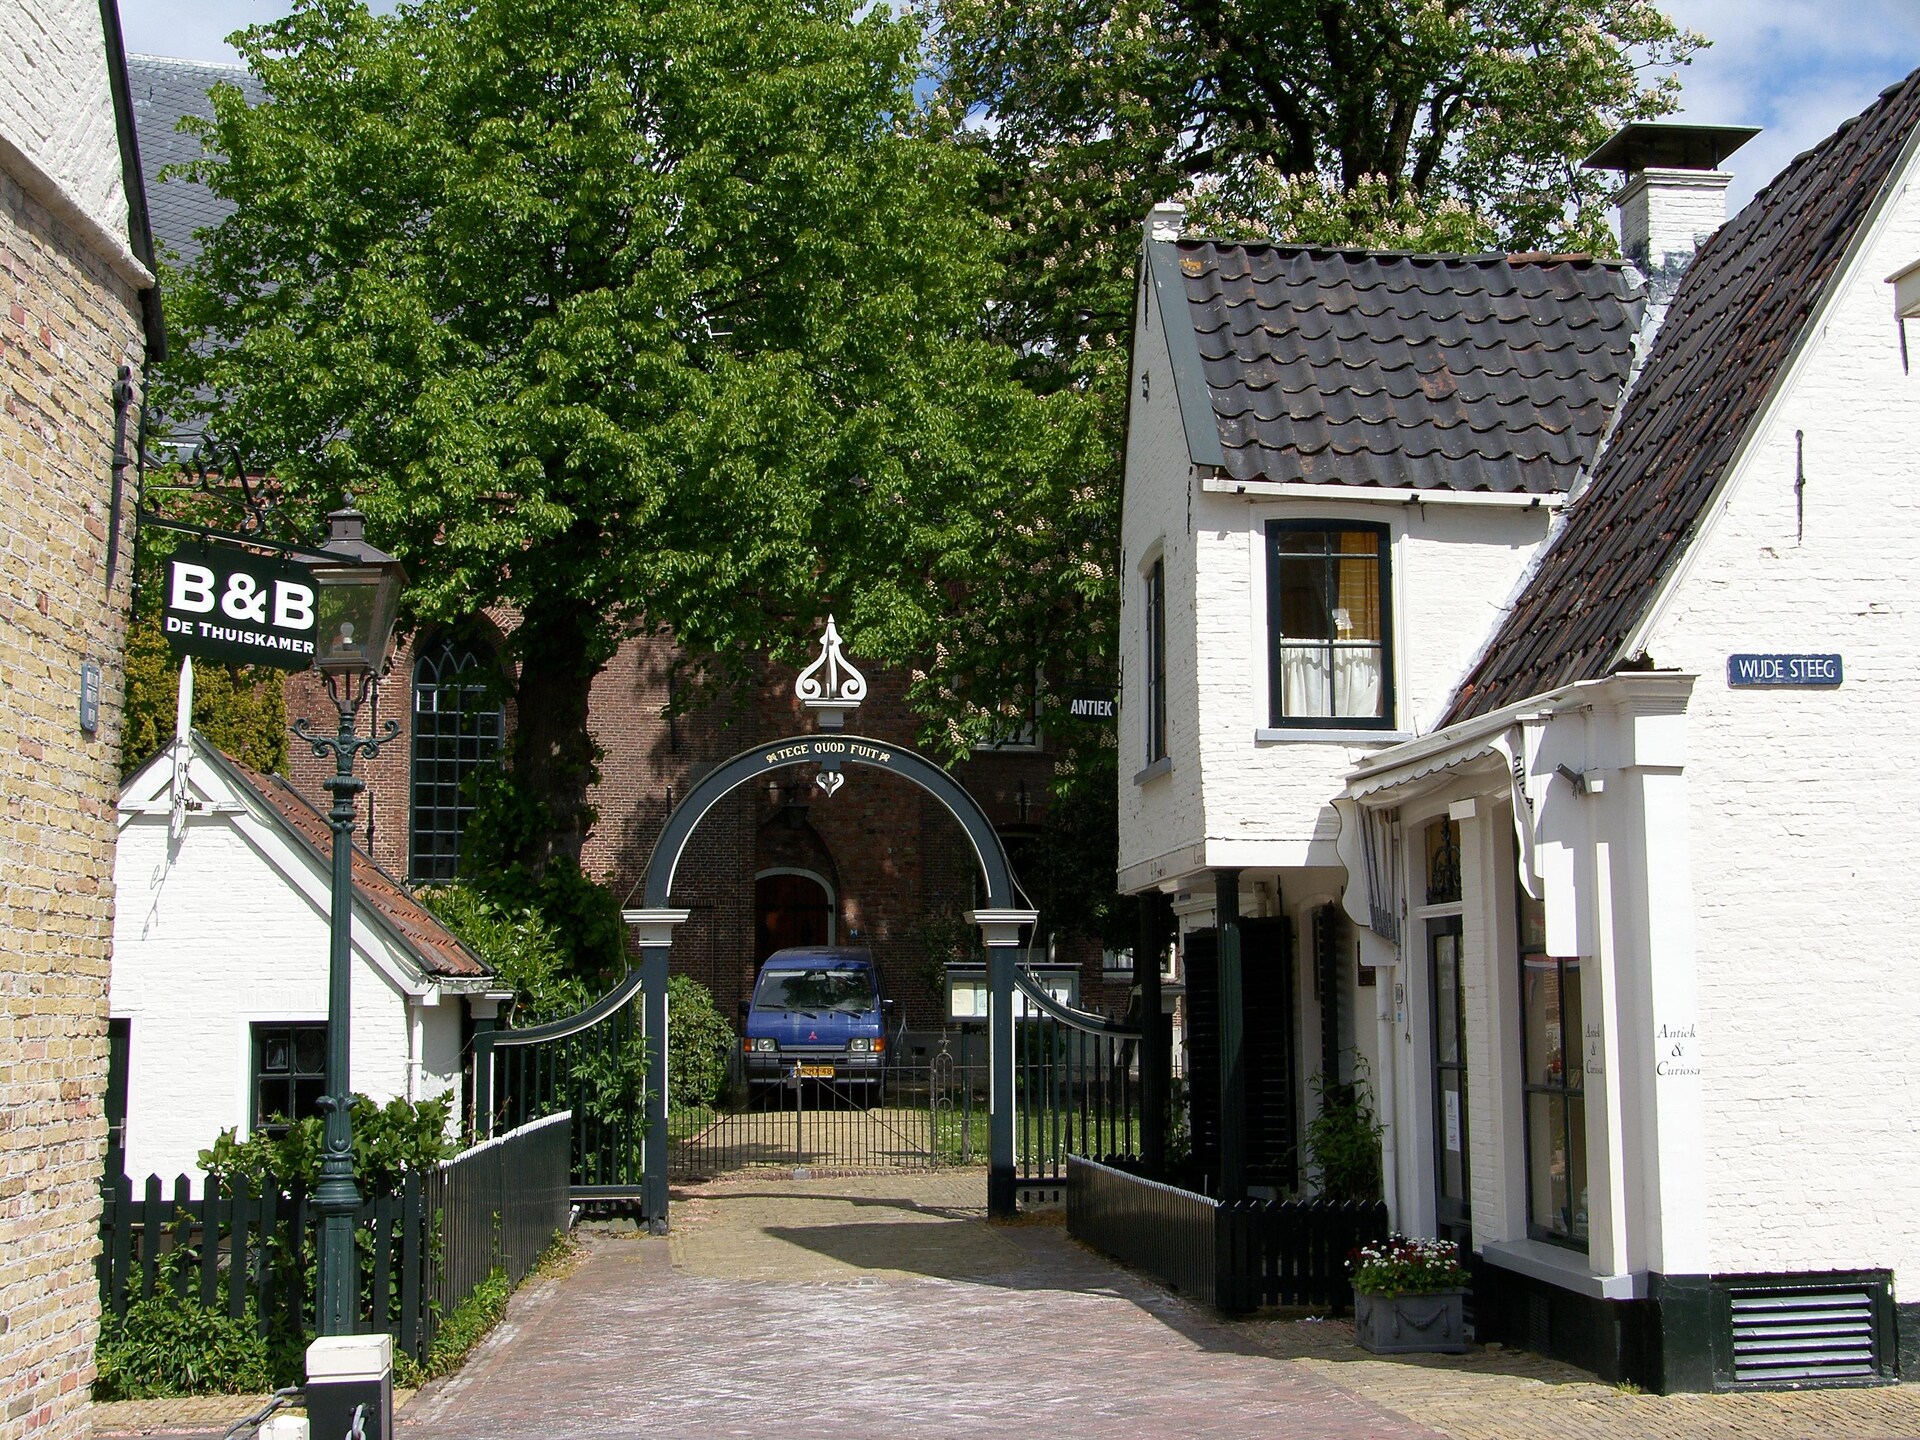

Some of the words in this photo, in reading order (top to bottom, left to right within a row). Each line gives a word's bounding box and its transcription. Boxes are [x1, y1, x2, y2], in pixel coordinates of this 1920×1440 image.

[169, 561, 315, 630] B&B
[166, 616, 193, 635] DE
[199, 621, 315, 654] THUISKAMER
[1739, 659, 1784, 678] WIJDE
[1790, 659, 1835, 678] STEEG
[1070, 699, 1112, 716] ANTIEK
[777, 744, 809, 759] TEGE
[814, 742, 845, 754] QUOD
[850, 744, 879, 759] FUIT
[1657, 1023, 1696, 1038] Antiek
[1671, 1042, 1684, 1057] &
[1656, 1060, 1701, 1076] Curiosa
